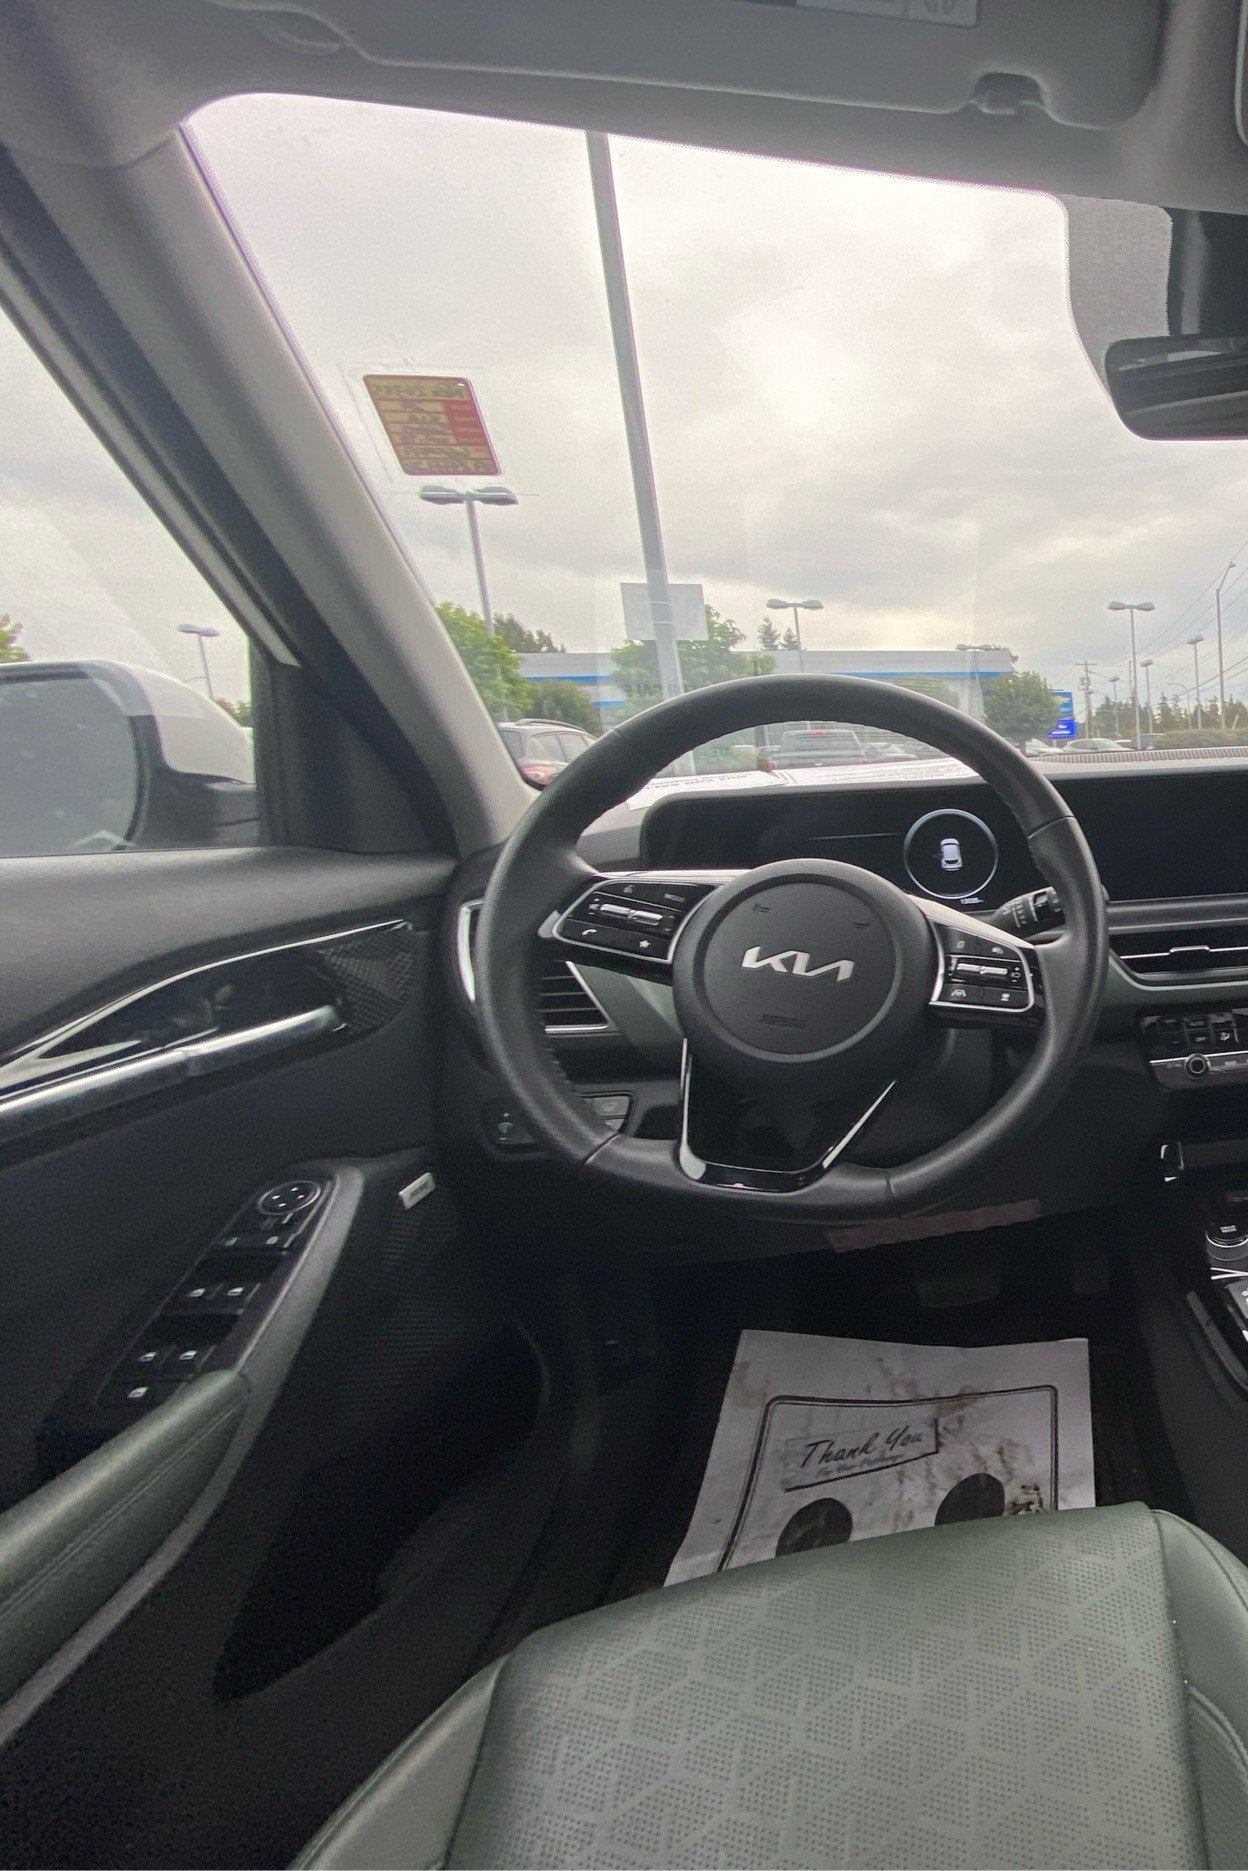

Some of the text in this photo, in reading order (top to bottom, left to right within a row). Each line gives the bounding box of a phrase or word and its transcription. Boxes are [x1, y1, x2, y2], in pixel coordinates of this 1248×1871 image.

[741, 946, 855, 982] KIA
[801, 1432, 881, 1468] Thank
[885, 1425, 923, 1451] You
